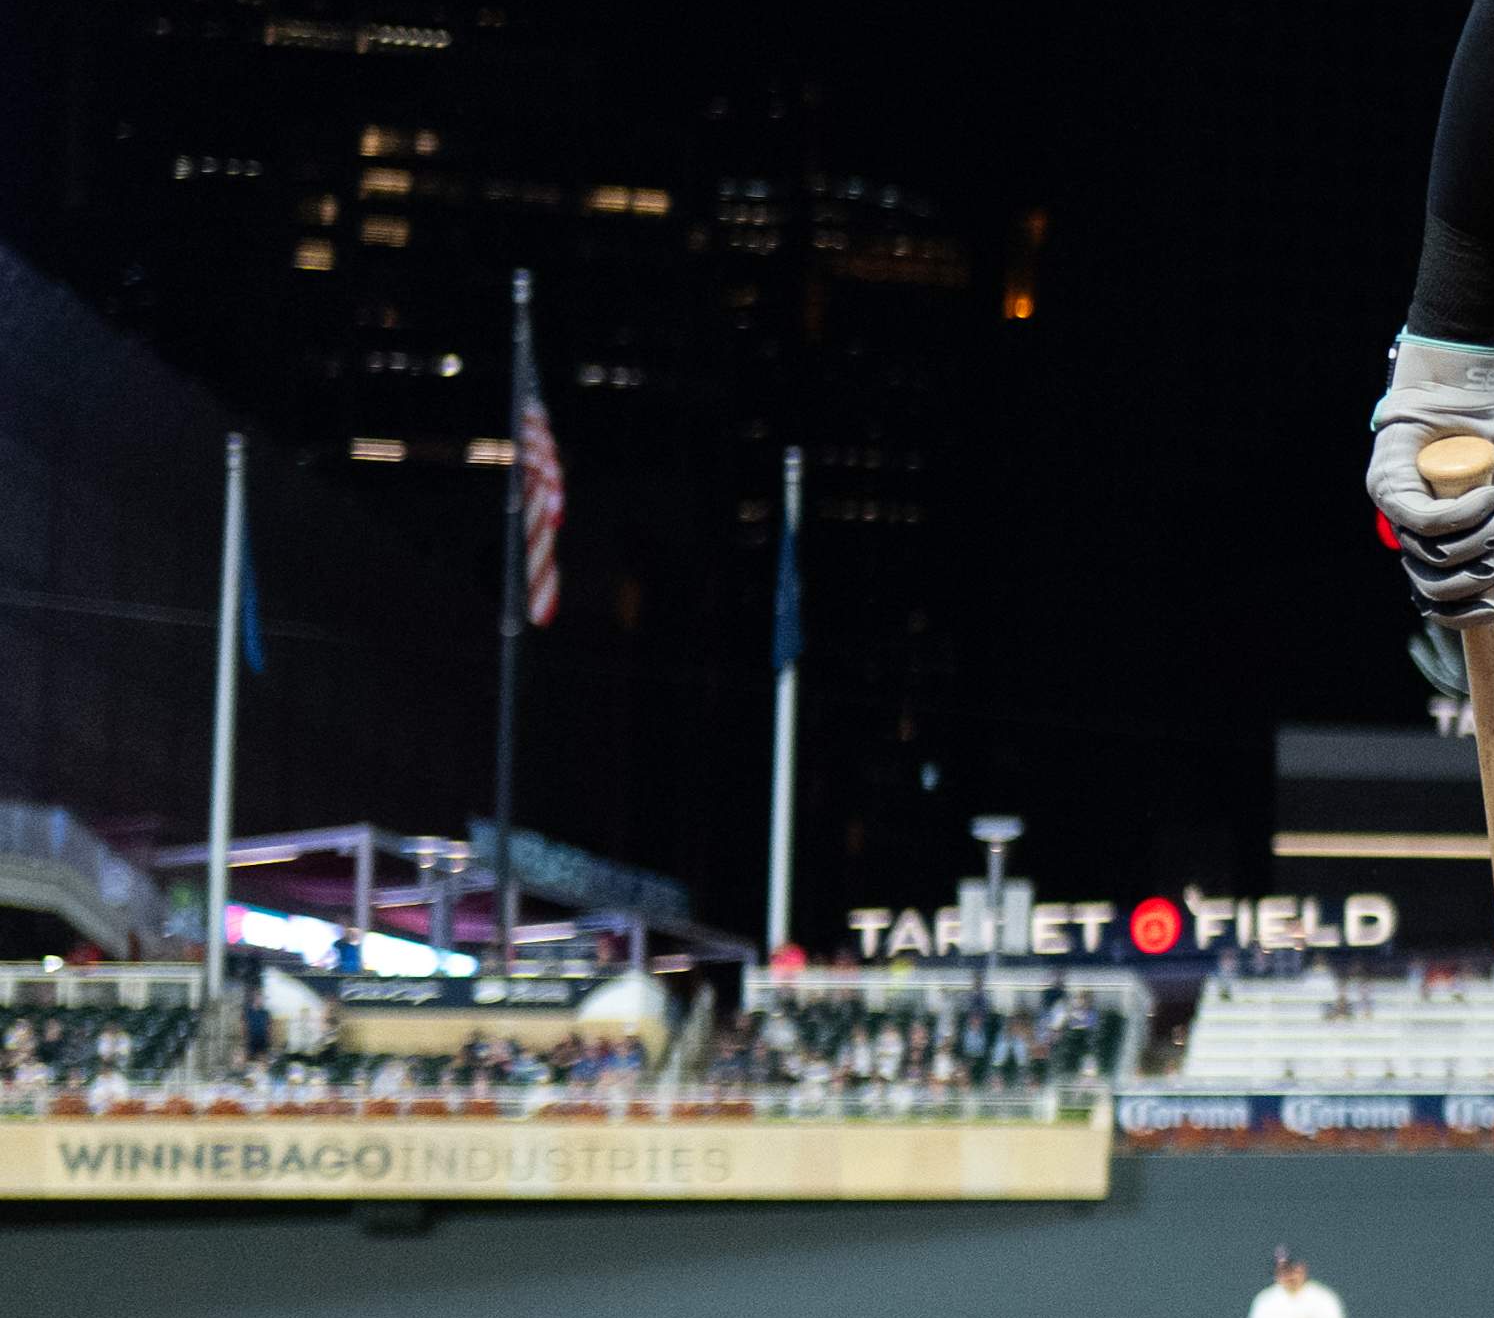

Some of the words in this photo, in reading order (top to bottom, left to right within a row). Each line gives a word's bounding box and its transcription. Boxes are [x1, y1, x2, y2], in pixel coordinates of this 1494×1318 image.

[848, 900, 1115, 959] TARET
[1194, 893, 1397, 951] FIELD
[58, 1142, 393, 1181] WINNEBAGO
[400, 1145, 734, 1182] INDUSTRIES
